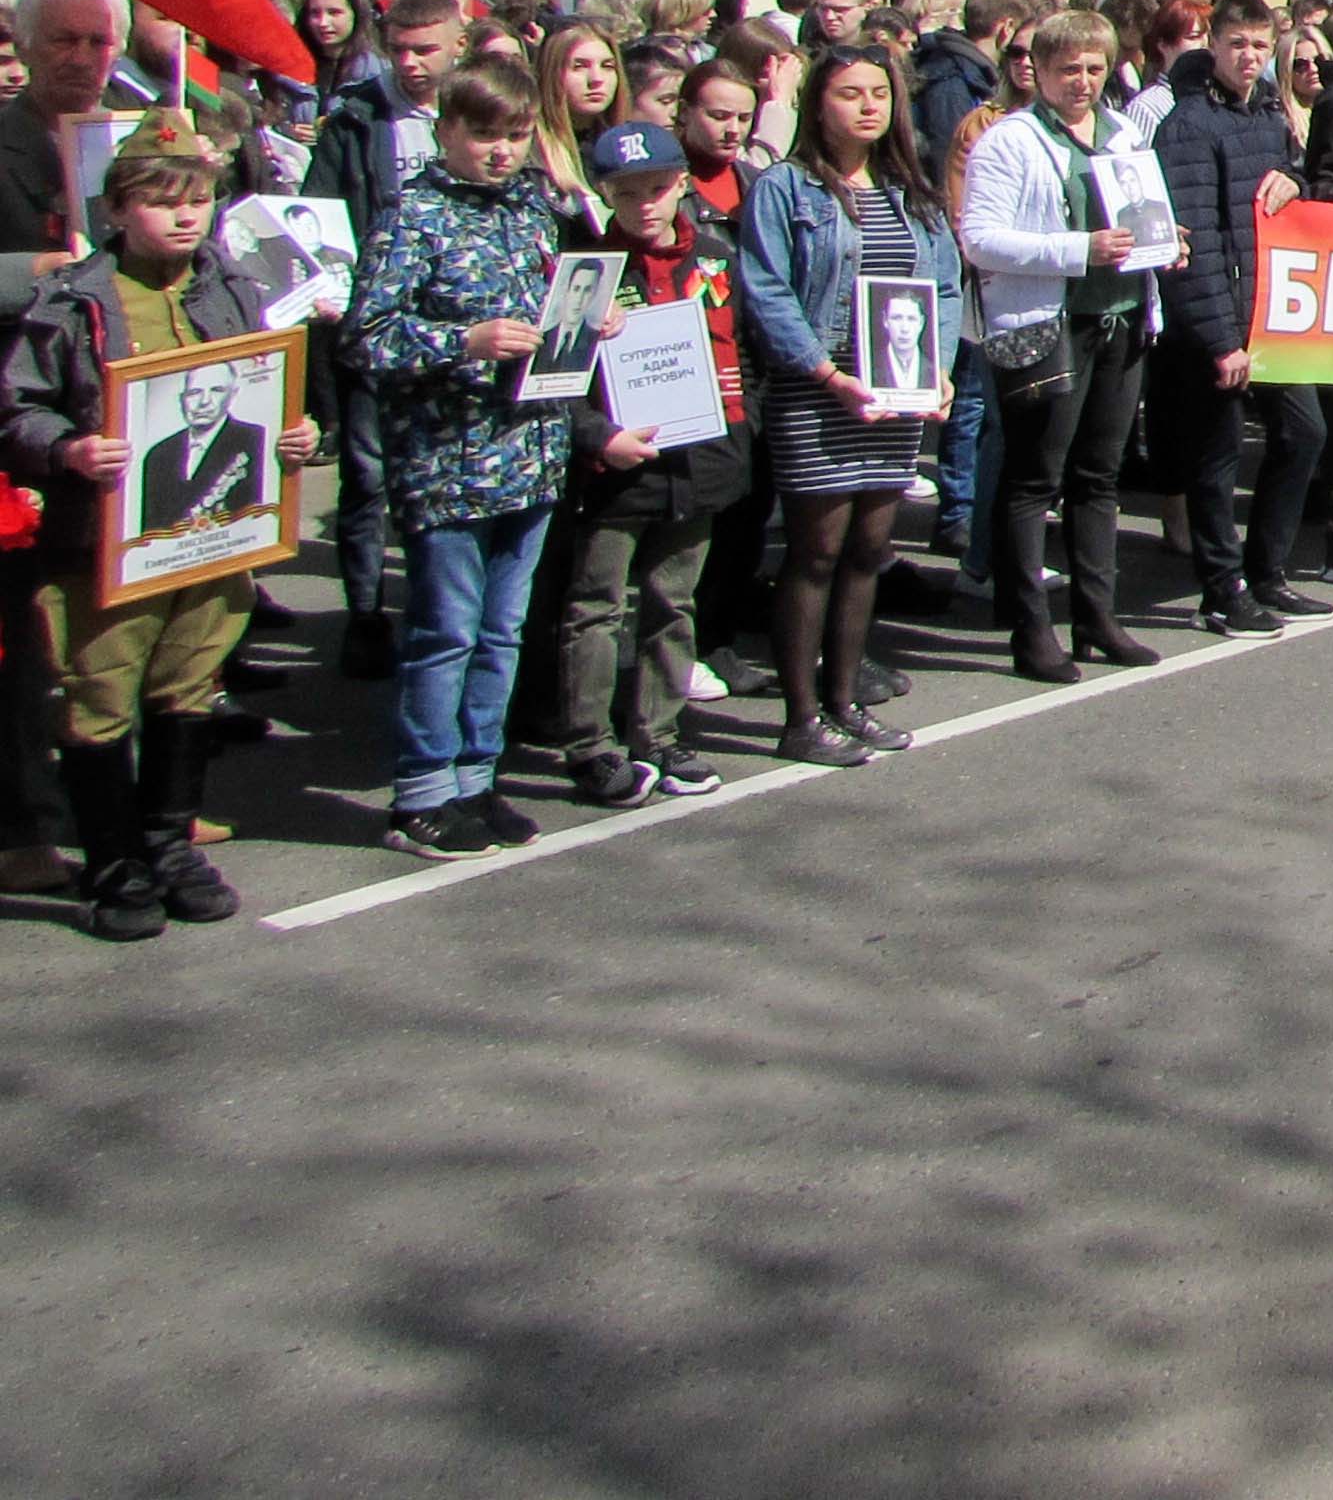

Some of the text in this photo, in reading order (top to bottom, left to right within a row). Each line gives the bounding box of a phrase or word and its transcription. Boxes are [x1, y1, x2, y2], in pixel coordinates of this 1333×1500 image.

[619, 339, 694, 364] СУПРУНЧИК
[642, 356, 679, 373] АДАМ
[627, 367, 695, 390] ПЕТРОВИЧ
